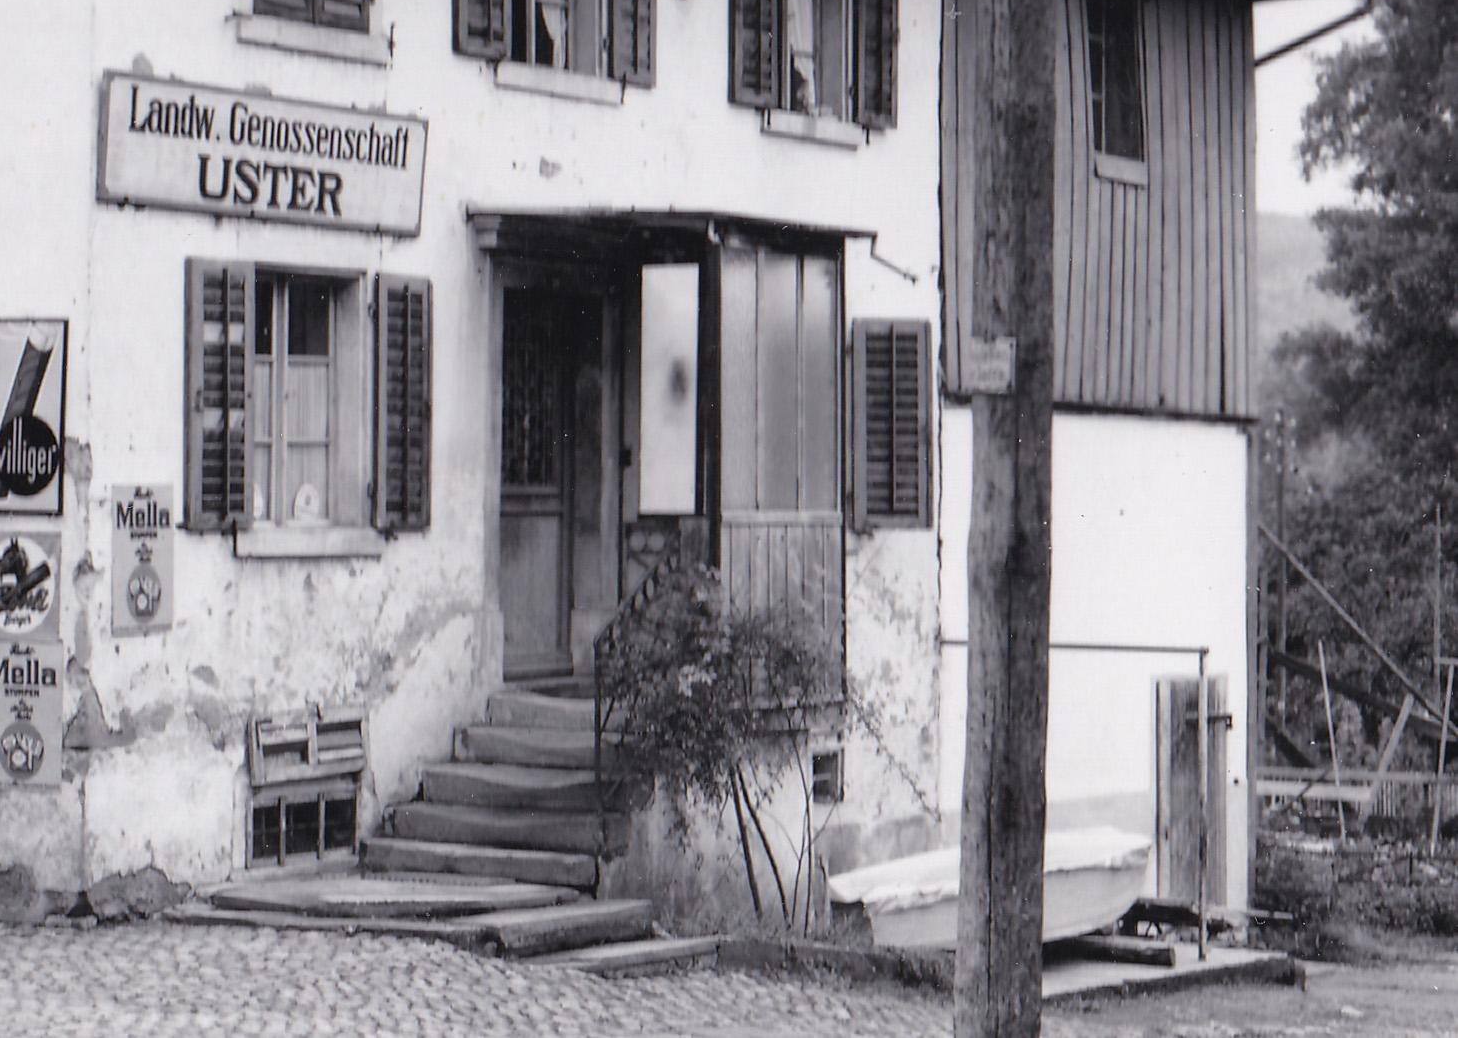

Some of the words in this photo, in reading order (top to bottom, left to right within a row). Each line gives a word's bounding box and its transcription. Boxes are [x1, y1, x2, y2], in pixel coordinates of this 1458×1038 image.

[128, 84, 221, 143] Landw.
[229, 100, 410, 171] Genossenschaft
[198, 153, 343, 216] USTER
[116, 500, 171, 531] Mella
